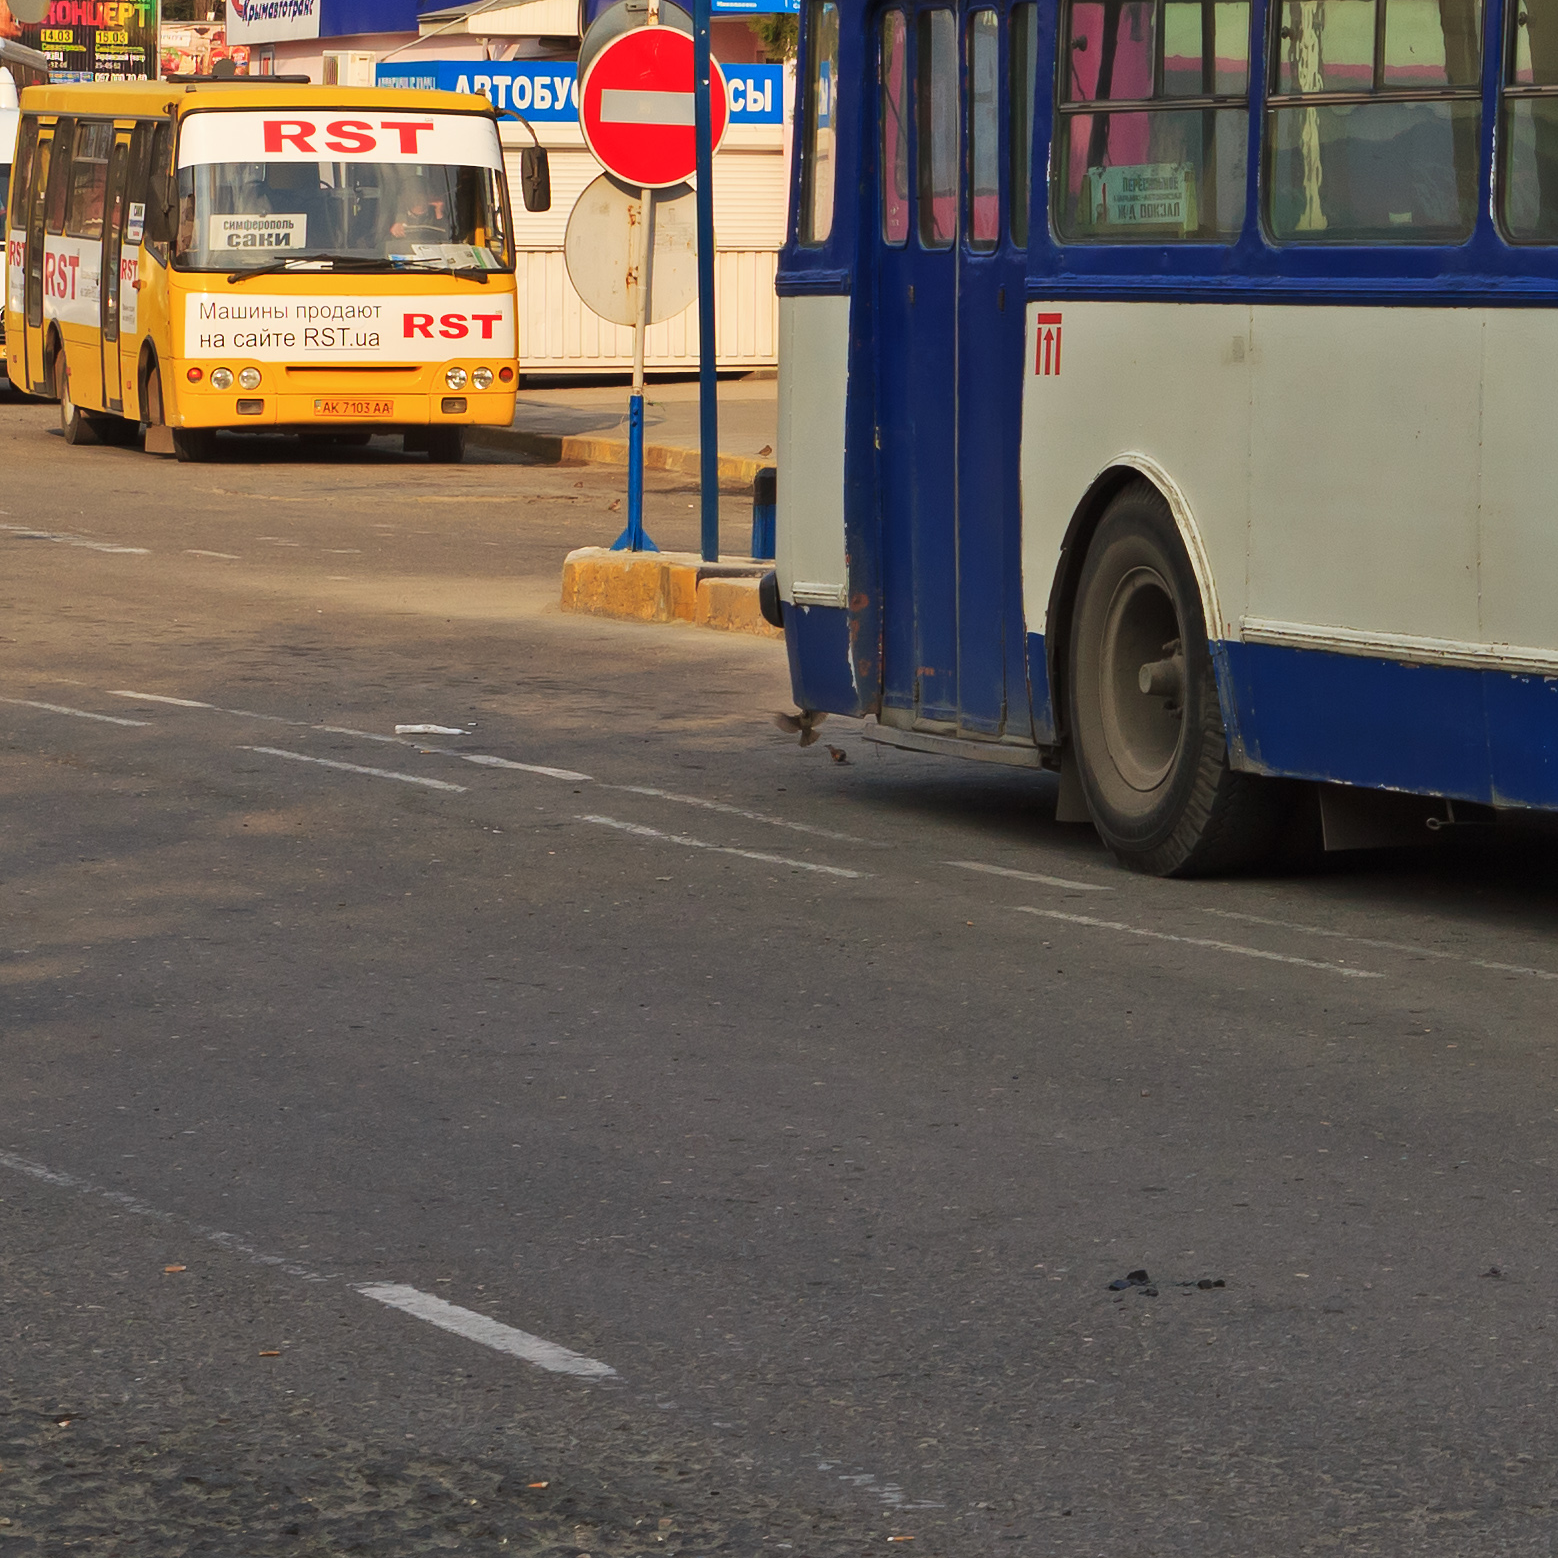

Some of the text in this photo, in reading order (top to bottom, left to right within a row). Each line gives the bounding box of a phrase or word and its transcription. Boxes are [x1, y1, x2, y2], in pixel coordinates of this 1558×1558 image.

[42, 31, 126, 43] 14.03 15.03
[263, 120, 434, 154] RST
[45, 252, 79, 300] RST
[121, 258, 138, 280] RST
[200, 302, 382, 322] Машины продают
[403, 313, 502, 339] RST
[200, 327, 380, 347] на сайте RST.ua
[342, 402, 371, 414] 7103
